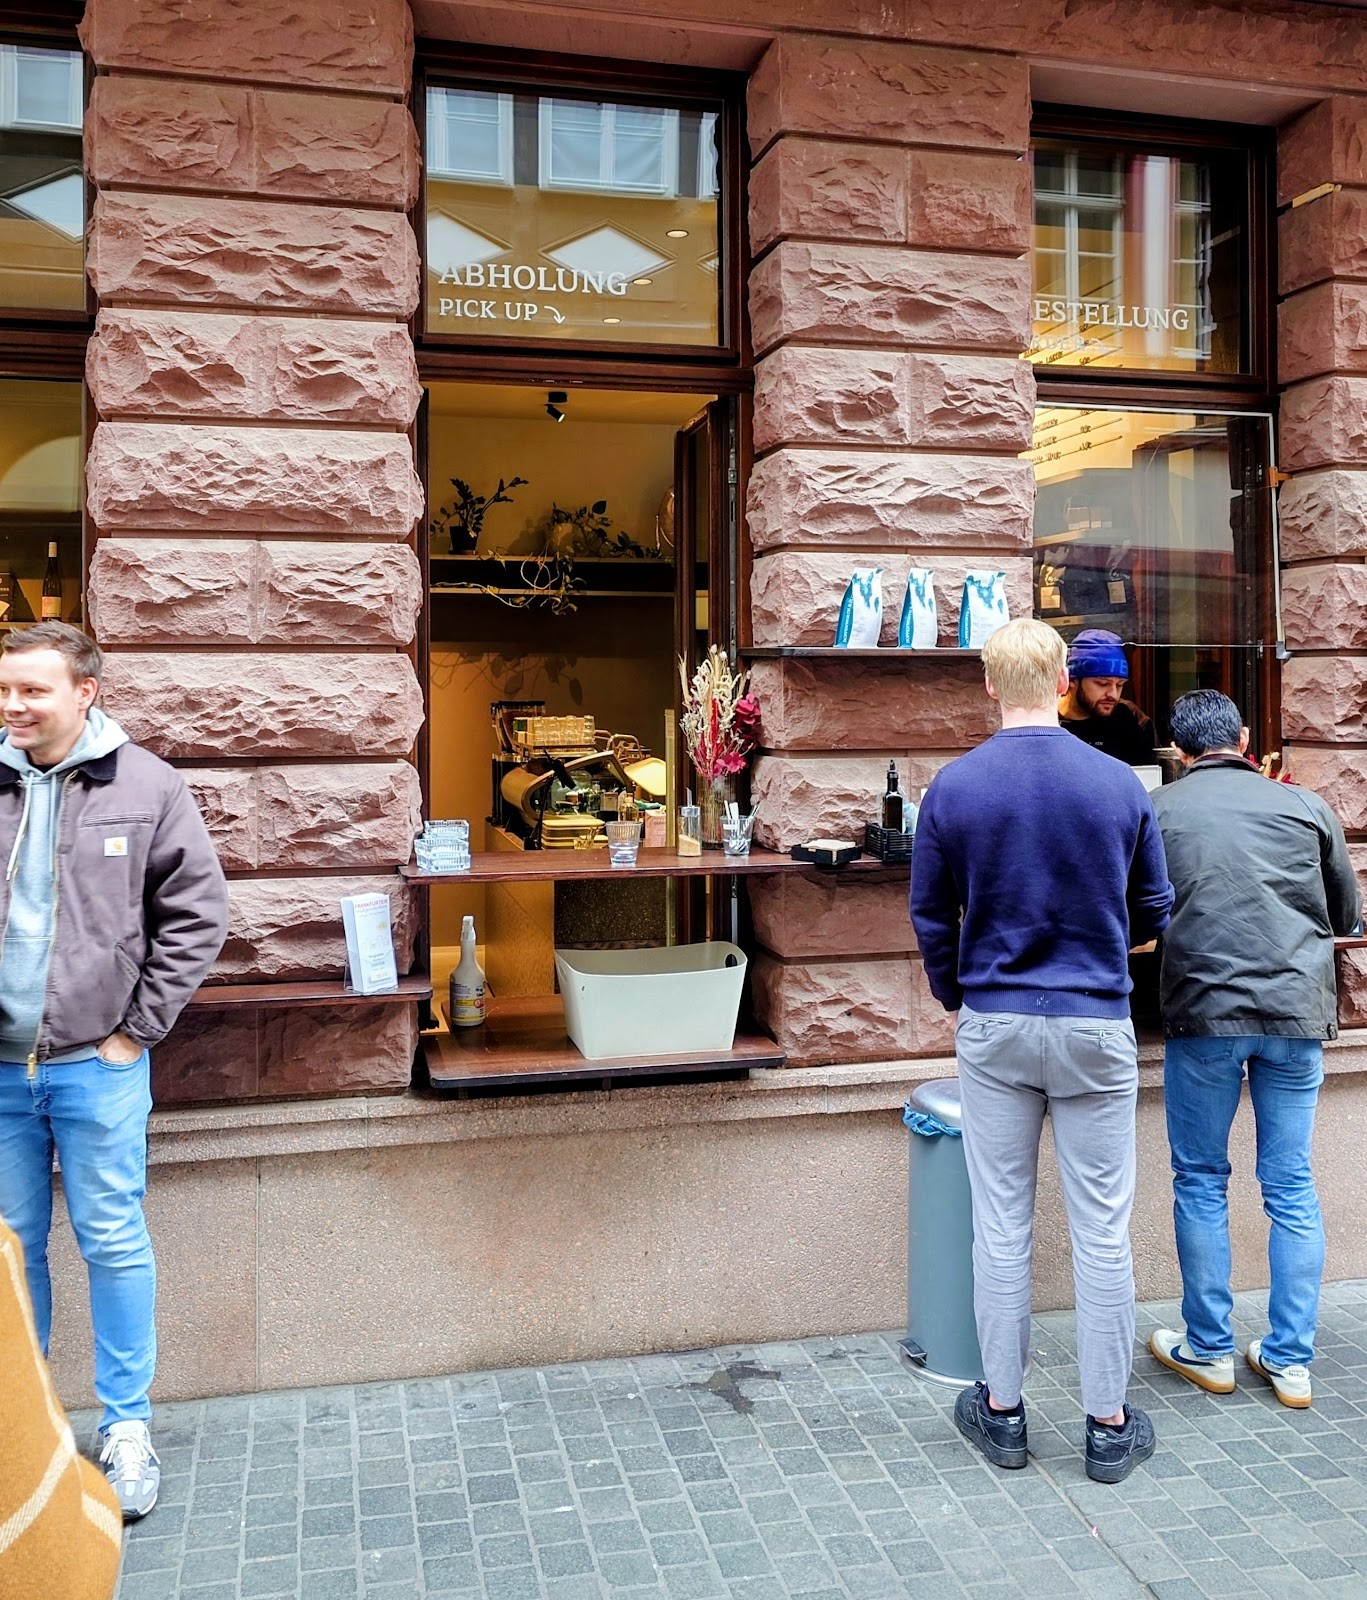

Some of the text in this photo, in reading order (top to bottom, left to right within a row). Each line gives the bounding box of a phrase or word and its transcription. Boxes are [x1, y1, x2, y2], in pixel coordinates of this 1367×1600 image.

[438, 263, 628, 295] ABHOLUNG
[438, 298, 538, 321] PICK UP
[1034, 300, 1189, 331] ESTELLUNG
[1031, 335, 1085, 350] RDER
